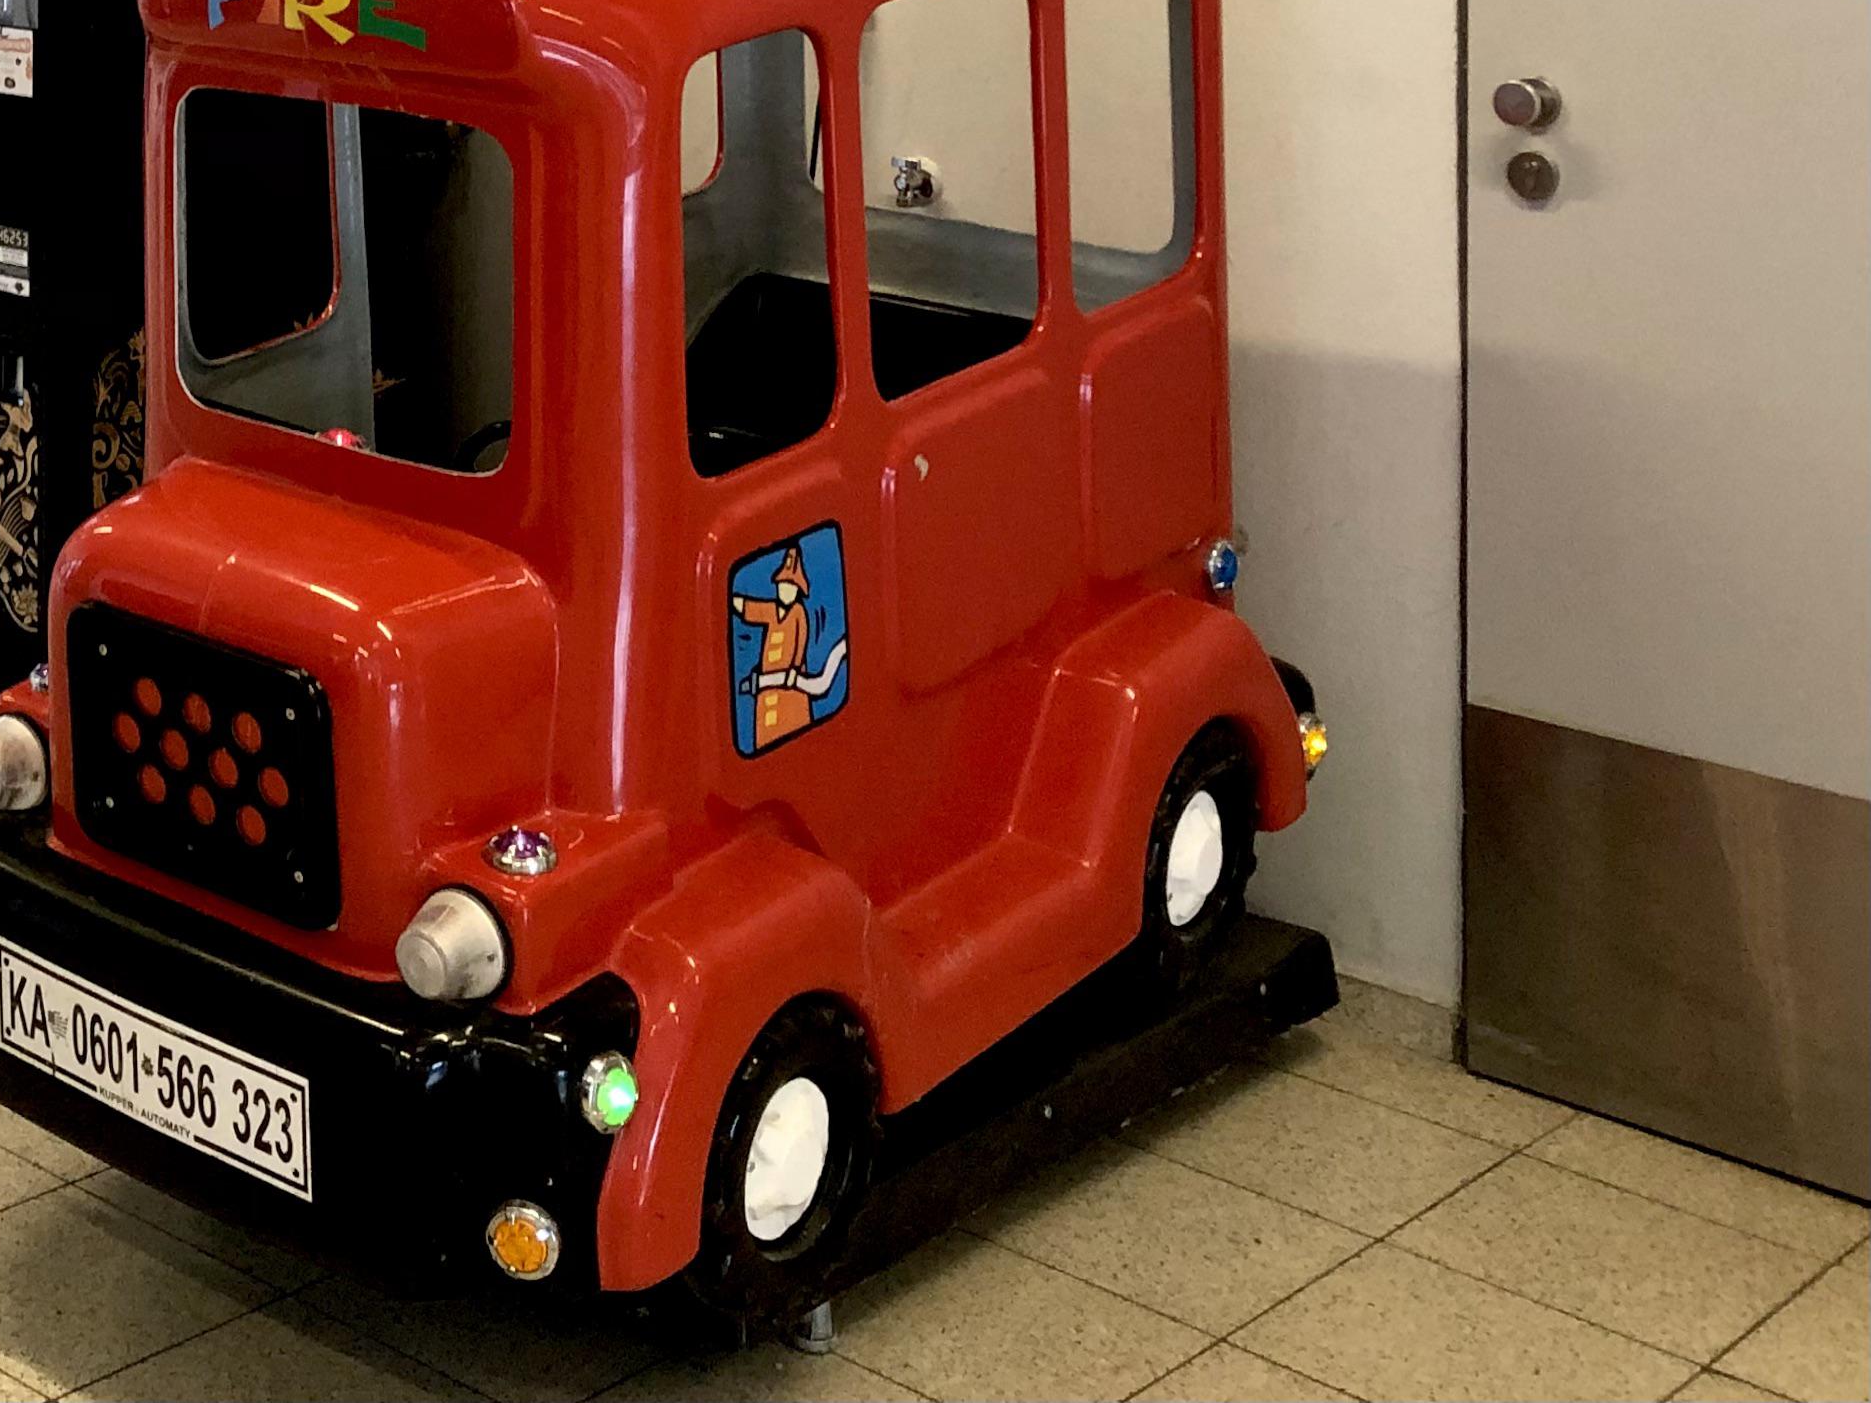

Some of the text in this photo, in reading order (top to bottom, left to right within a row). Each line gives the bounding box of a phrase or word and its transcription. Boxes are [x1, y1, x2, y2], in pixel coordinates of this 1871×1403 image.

[9, 969, 51, 1048] KA
[232, 1079, 293, 1163] 323
[141, 1108, 191, 1138] AUTOMATY
